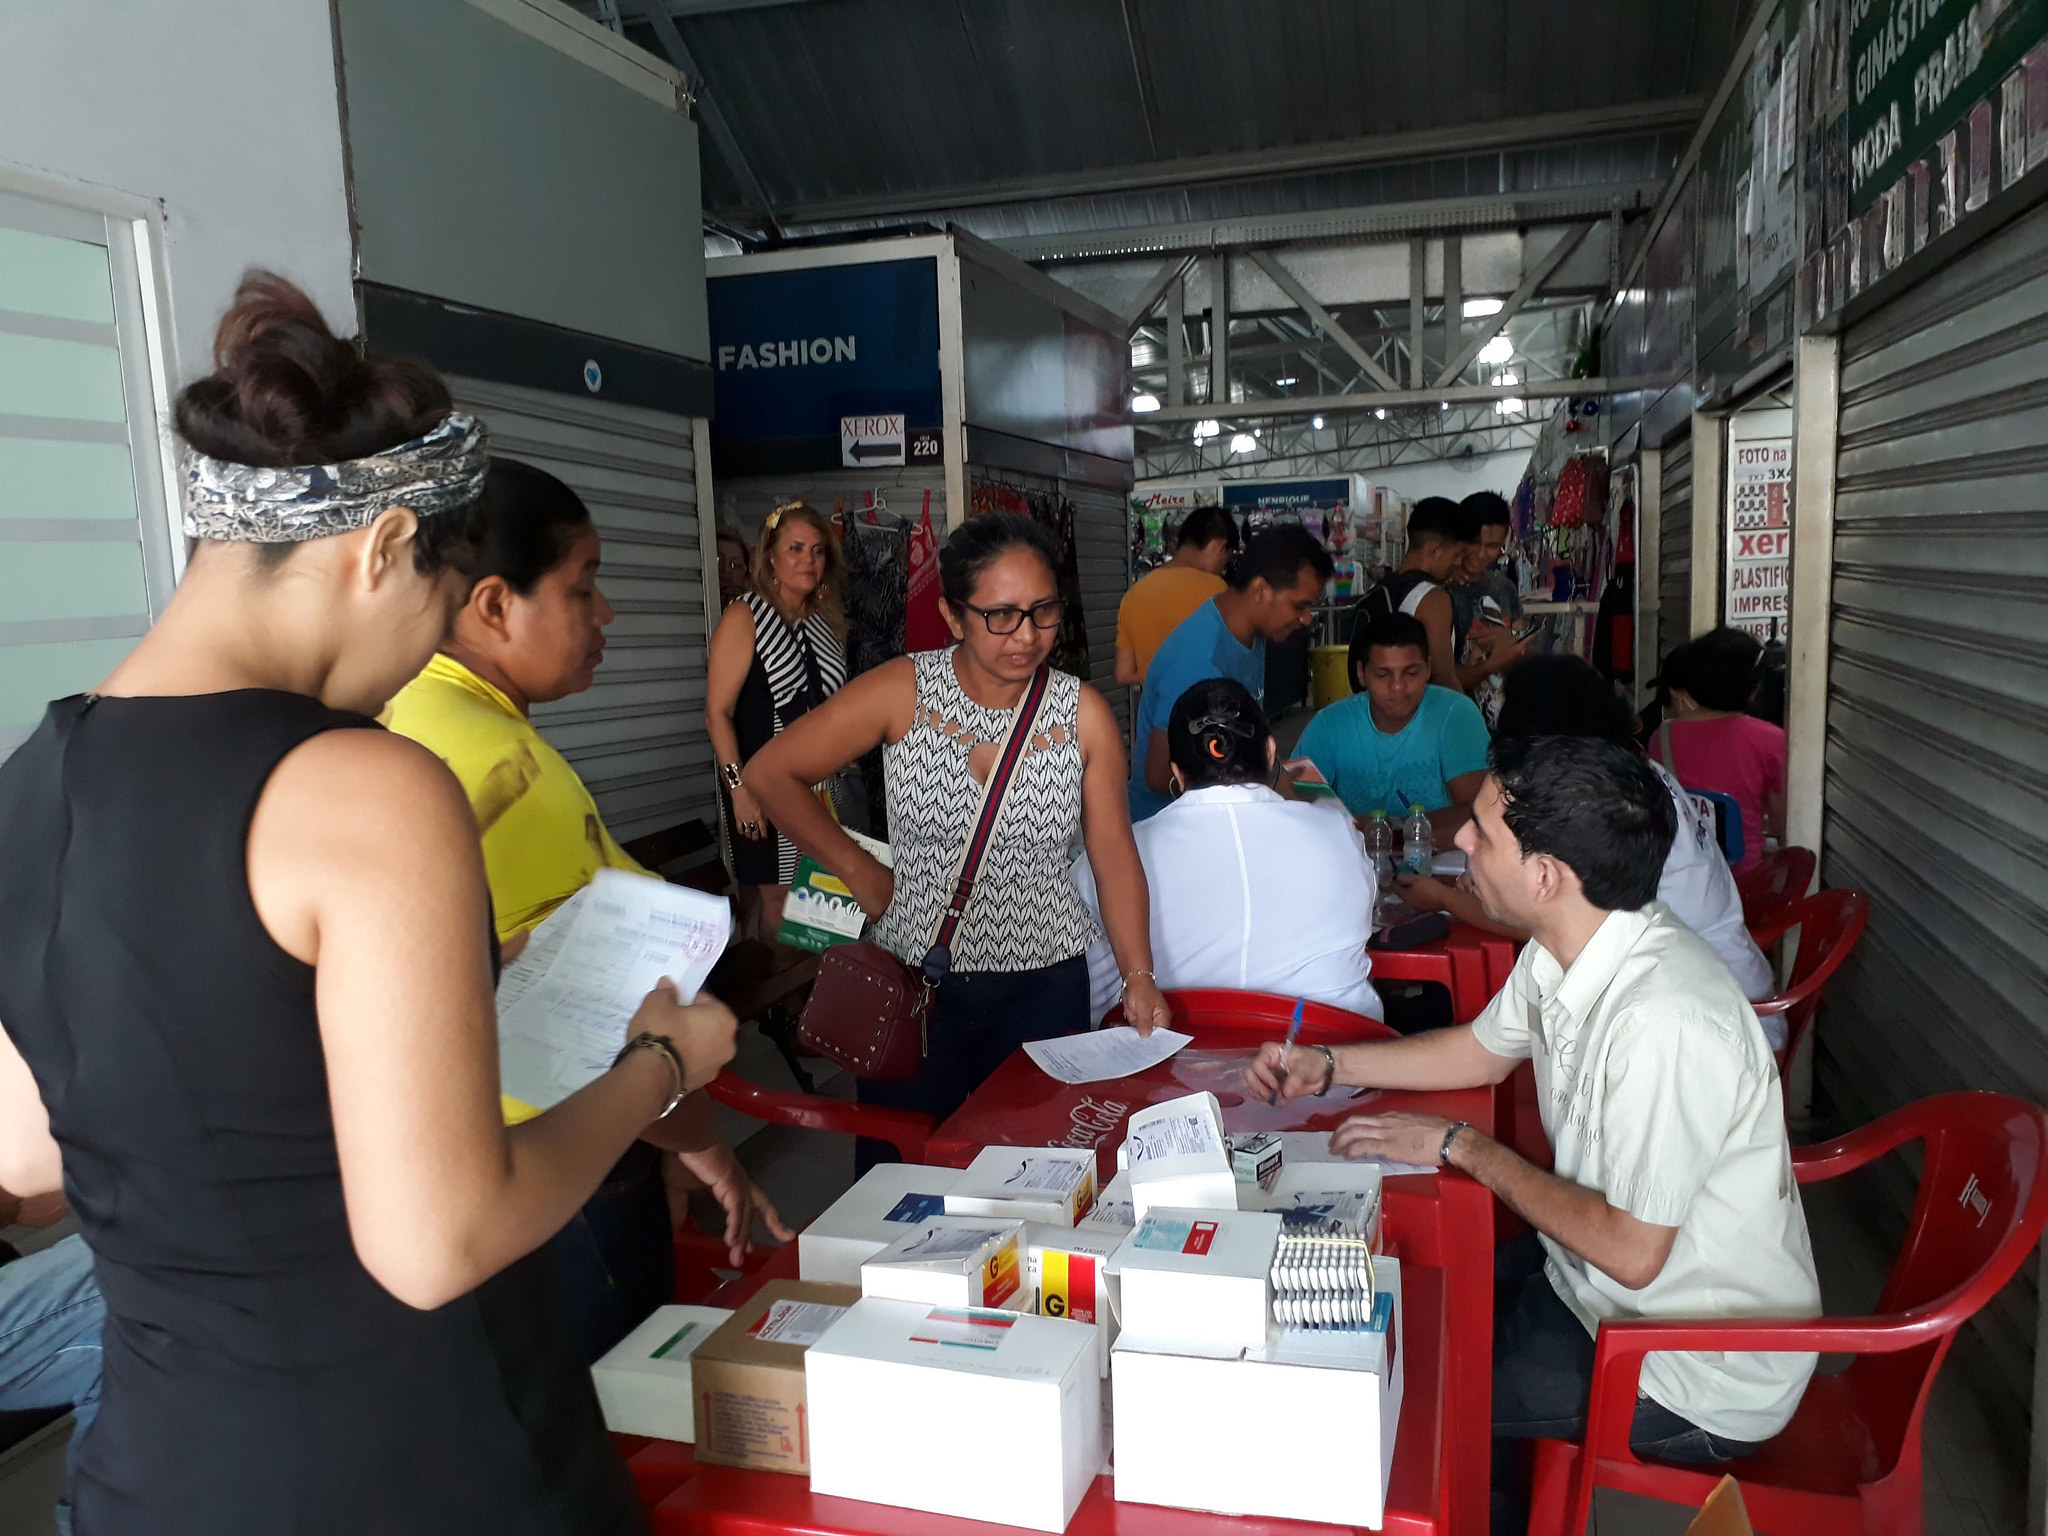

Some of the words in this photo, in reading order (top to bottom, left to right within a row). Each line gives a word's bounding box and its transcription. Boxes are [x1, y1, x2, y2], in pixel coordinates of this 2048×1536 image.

[1852, 100, 1902, 194] MODA
[718, 334, 857, 371] FASHION
[842, 416, 899, 437] XEROX
[913, 439, 938, 457] 220
[1738, 447, 1769, 465] FOTO
[1773, 448, 1787, 462] na
[1738, 532, 1788, 556] xer
[989, 1255, 999, 1280] G
[1044, 1293, 1065, 1317] G
